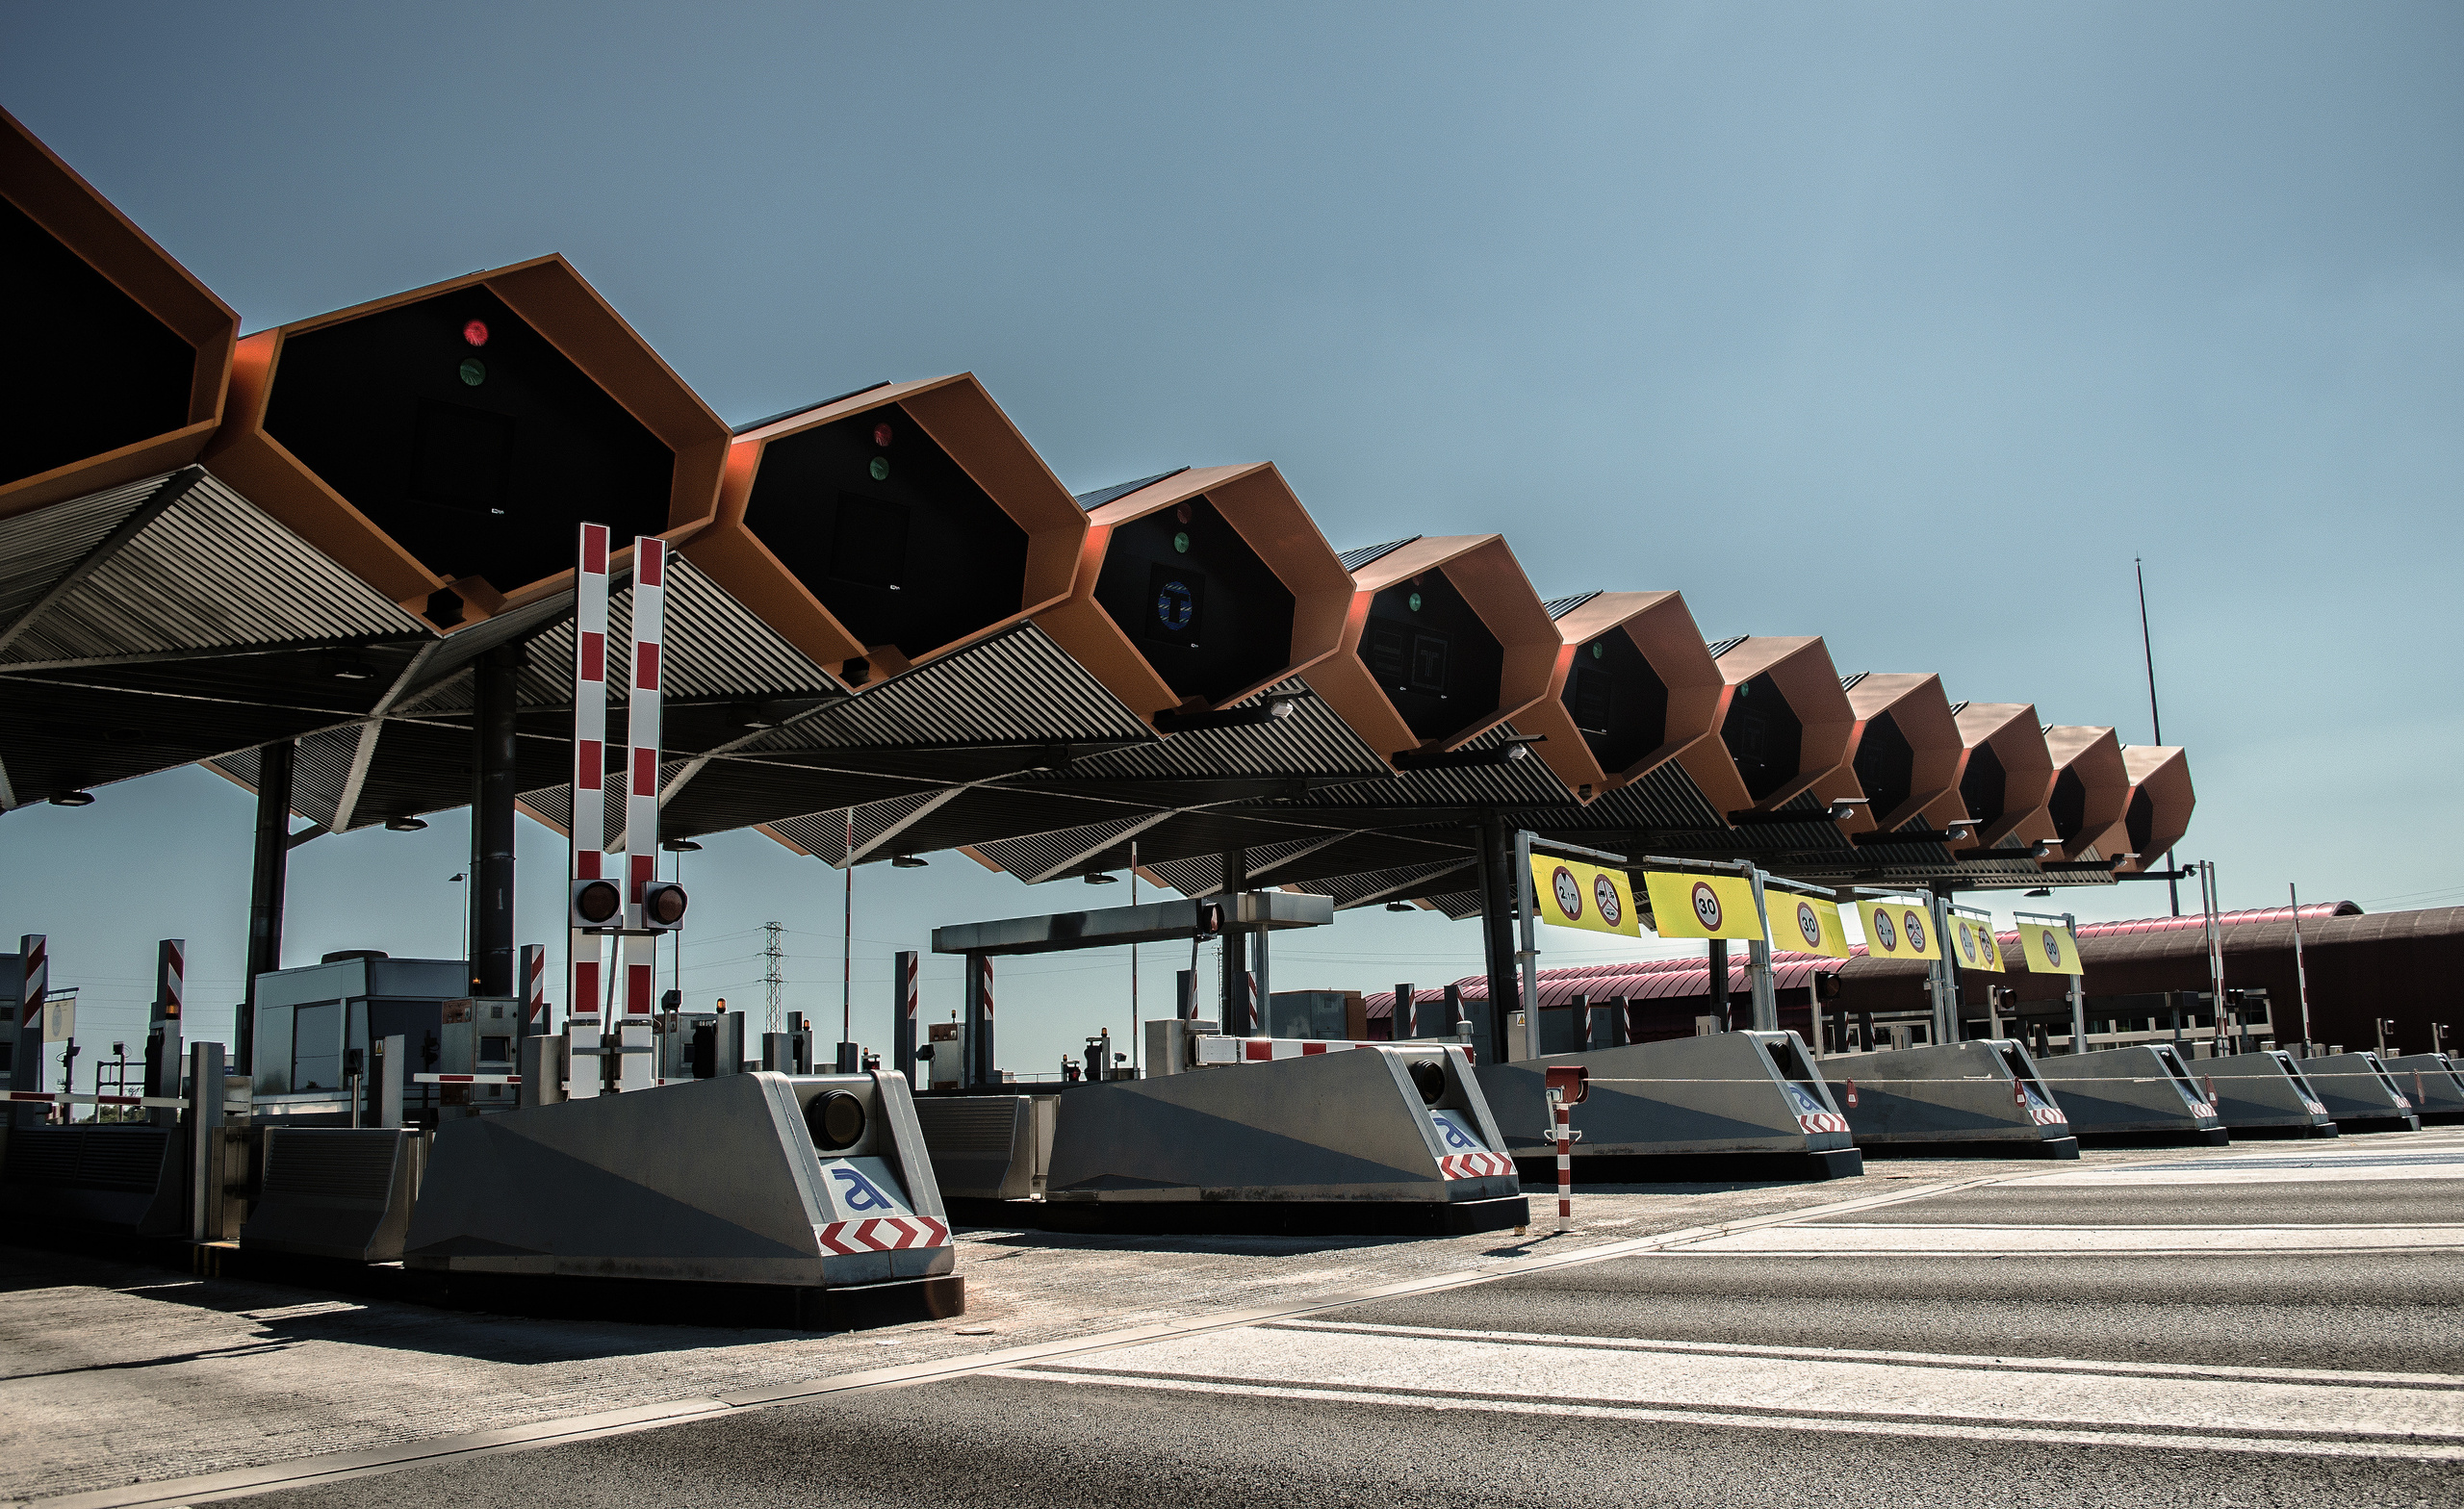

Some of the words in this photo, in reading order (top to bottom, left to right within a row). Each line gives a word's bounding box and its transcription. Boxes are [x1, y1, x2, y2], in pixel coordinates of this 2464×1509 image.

[1162, 588, 1190, 624] T
[1698, 897, 1716, 915] 30
[1802, 916, 1816, 934] 30
[2046, 942, 2057, 956] 30
[831, 1168, 895, 1213] a
